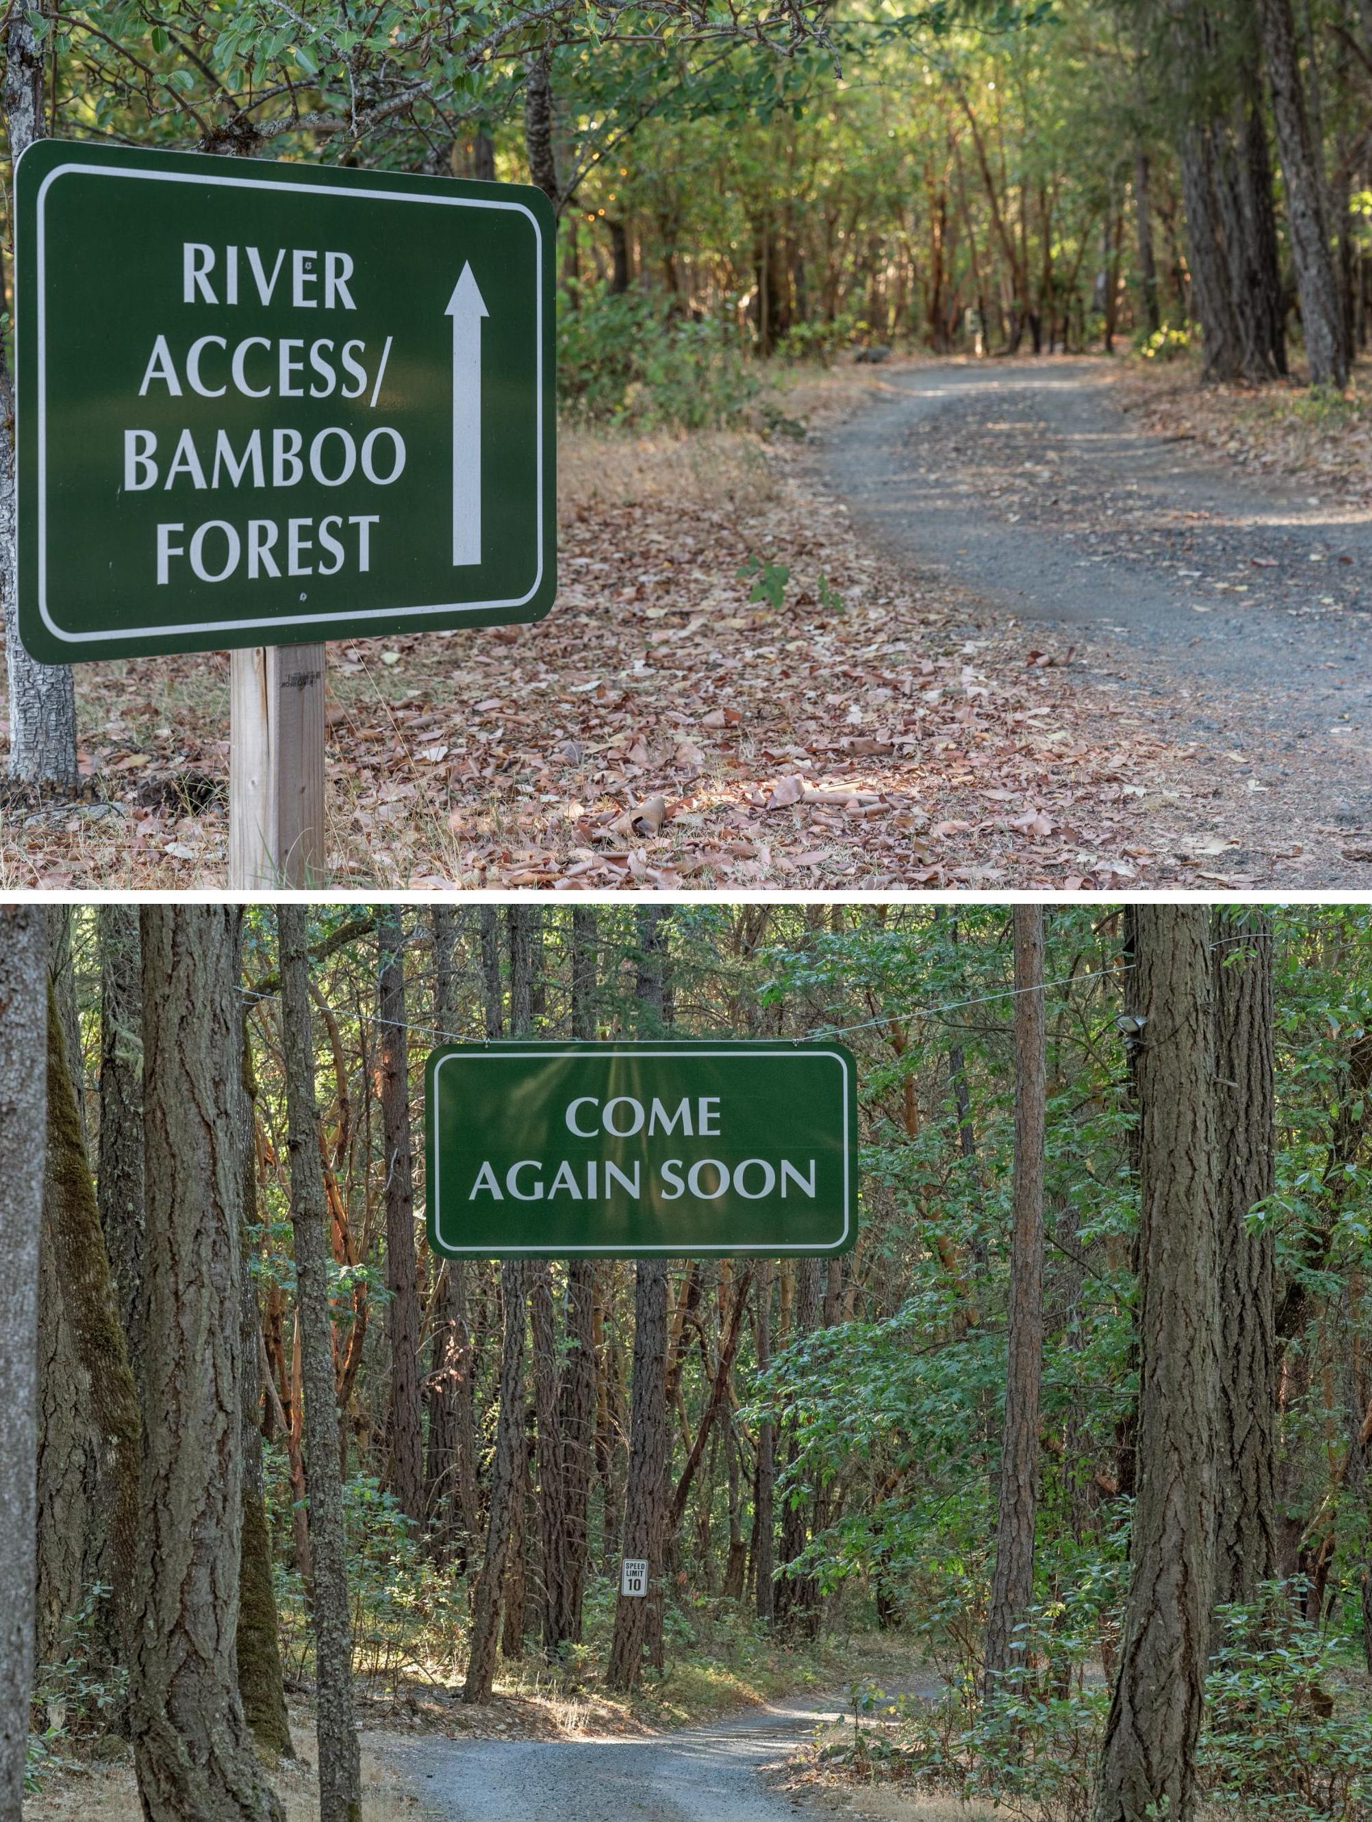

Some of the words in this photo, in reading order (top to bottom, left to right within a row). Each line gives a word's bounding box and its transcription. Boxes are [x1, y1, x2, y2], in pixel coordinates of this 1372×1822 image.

[182, 242, 357, 310] RIVER
[138, 334, 393, 408] ACCESS/
[123, 426, 406, 491] BAMBOO
[156, 514, 380, 585] FOREST
[565, 1096, 721, 1138] COME
[469, 1160, 640, 1201] AGAIN
[660, 1158, 816, 1200] SOON
[625, 1562, 645, 1570] SPEED
[628, 1578, 641, 1591] 10
